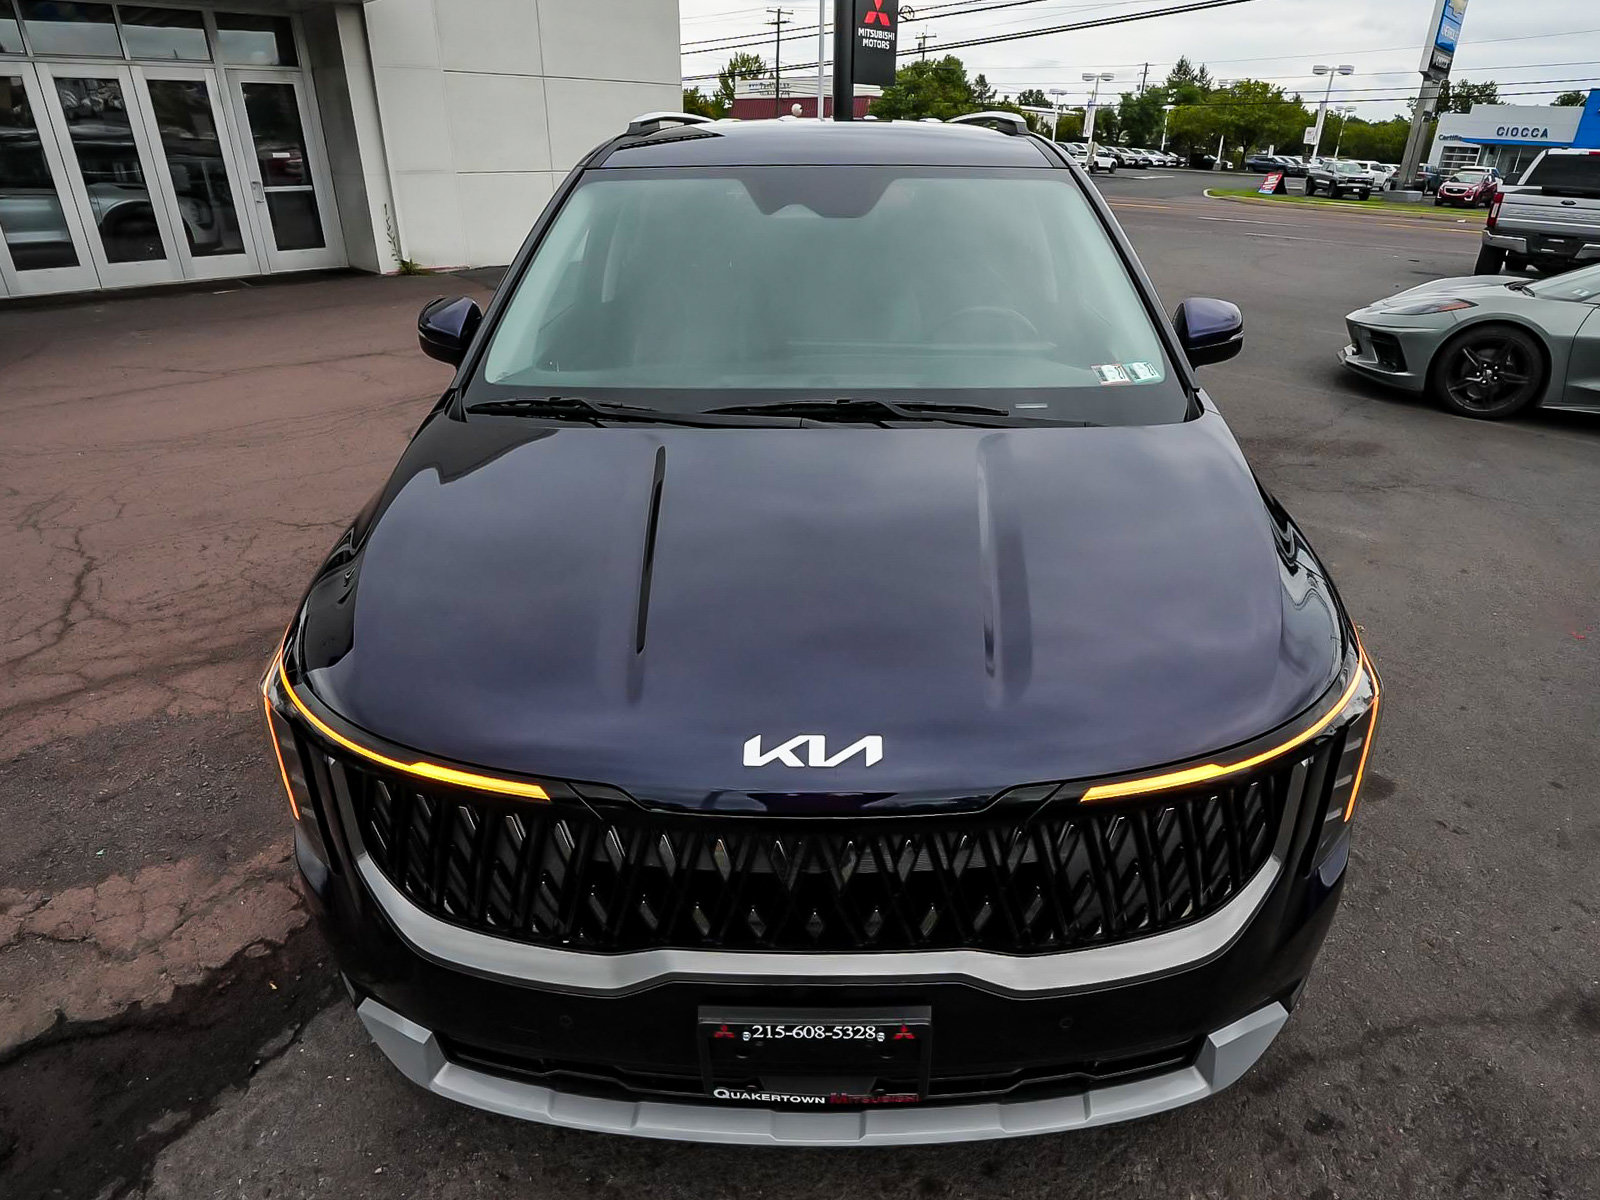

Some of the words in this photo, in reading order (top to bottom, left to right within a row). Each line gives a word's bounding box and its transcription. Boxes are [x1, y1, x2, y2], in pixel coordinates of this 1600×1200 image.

[858, 27, 895, 41] MITSUBISHI
[862, 38, 890, 50] MOTORS
[1496, 126, 1549, 138] CIOCCA
[743, 734, 883, 768] KIA
[751, 1024, 876, 1040] 215-608-5328
[713, 1088, 826, 1104] QUAKERTOWN
